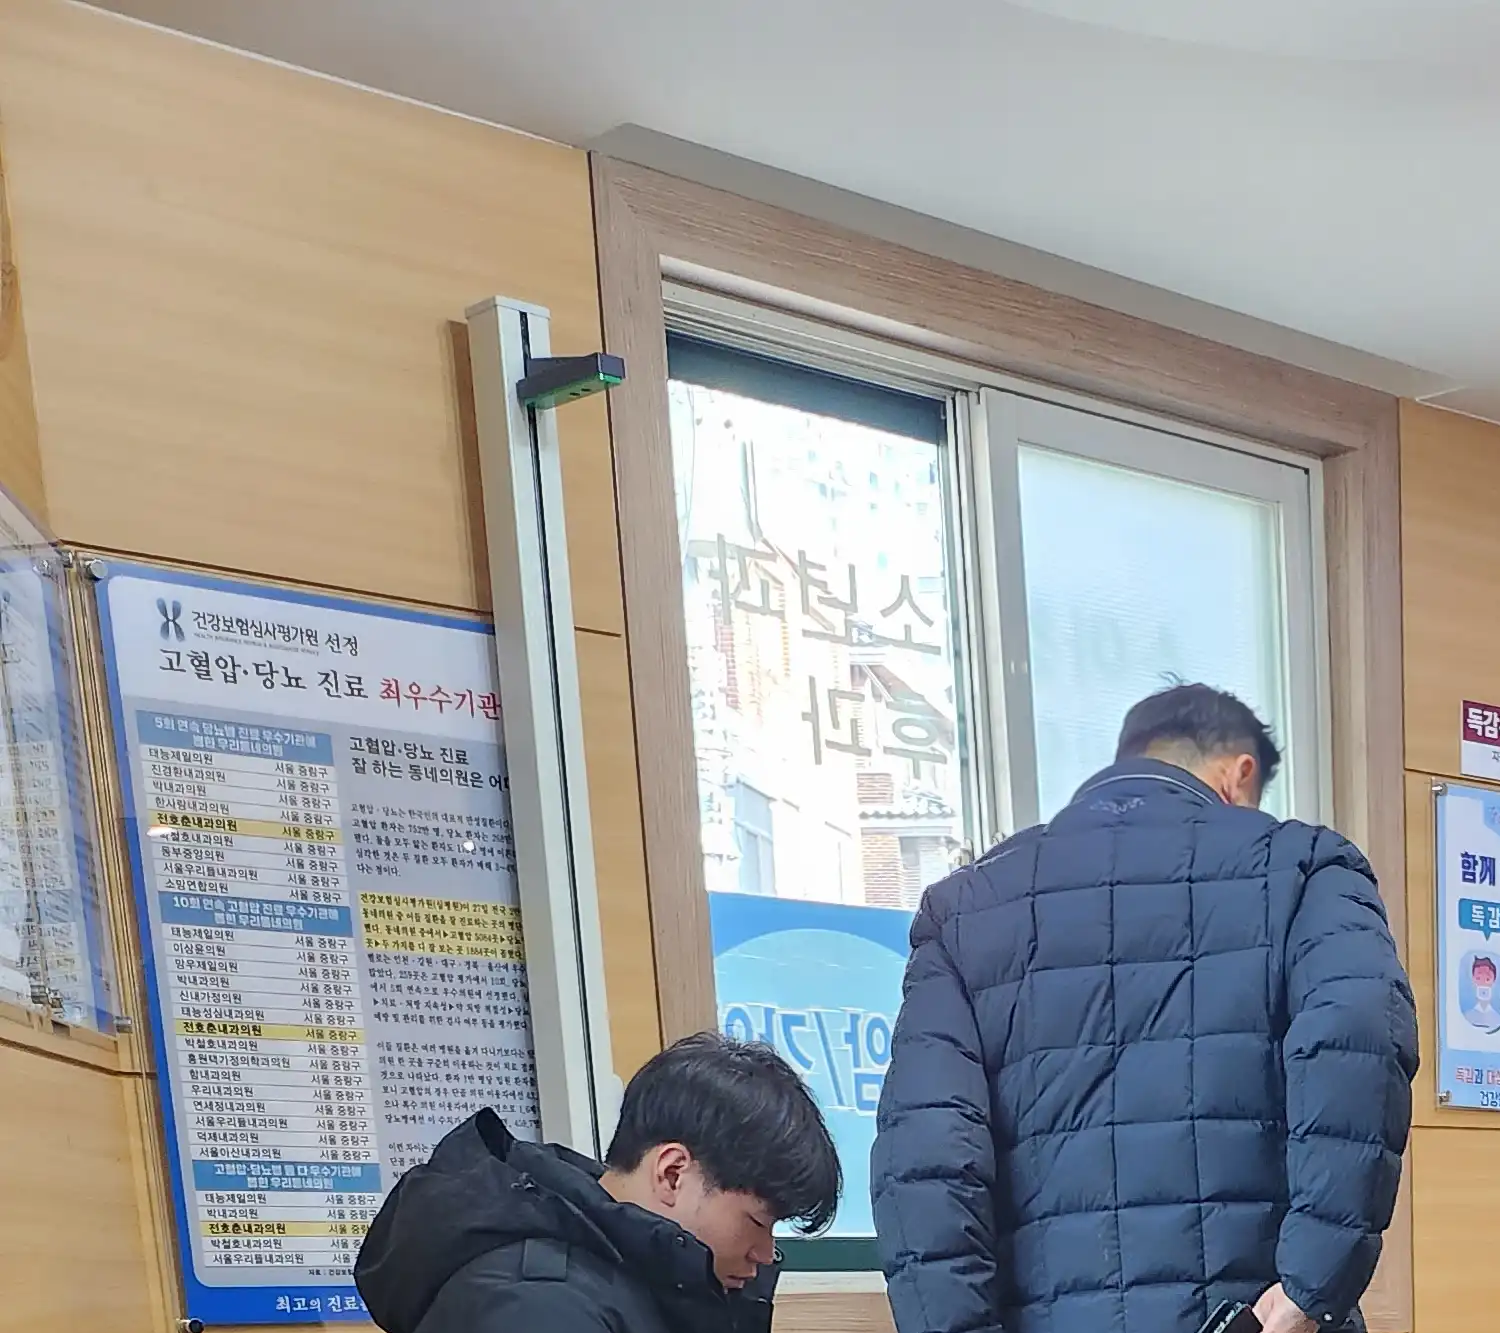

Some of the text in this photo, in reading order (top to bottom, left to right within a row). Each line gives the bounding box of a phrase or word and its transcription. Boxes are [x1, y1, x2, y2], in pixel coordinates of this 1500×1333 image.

[191, 610, 319, 646] 건강보험심사평가원
[324, 632, 359, 657] 선정
[159, 648, 501, 721] 고혈압·당뇨 진료 최우수기관
[349, 736, 469, 766] 고혈압·당뇨 진료
[274, 762, 294, 775] 서울
[351, 757, 367, 775] 잘
[372, 760, 403, 779] 하는
[408, 764, 484, 789] 동네의원은
[276, 778, 296, 791] 서울
[152, 780, 207, 797] 박내과의원
[278, 794, 298, 807] 서울
[280, 810, 300, 823] 서울
[282, 825, 302, 839] 서울
[284, 842, 303, 855] 서울
[286, 857, 305, 870] 서울
[1460, 851, 1496, 887] 함께
[287, 873, 307, 886] 서울
[289, 889, 309, 901] 서울
[295, 936, 314, 949] 서울
[296, 951, 316, 963] 서울
[299, 967, 318, 979] 서울
[177, 974, 230, 988] 박내과의원
[300, 982, 320, 994] 서울
[302, 997, 322, 1010] 서울
[304, 1013, 323, 1025] 서울
[305, 1028, 325, 1040] 서울
[307, 1043, 327, 1055] 서울
[309, 1058, 329, 1071] 서울
[310, 1074, 330, 1086] 서울
[313, 1089, 332, 1101] 서울
[315, 1104, 334, 1116] 서울
[316, 1119, 336, 1131] 서울
[318, 1134, 338, 1146] 서울
[320, 1149, 339, 1161] 서울
[325, 1194, 344, 1205] 서울
[207, 1208, 259, 1220] 박내과의원
[327, 1208, 346, 1220] 서울
[329, 1223, 347, 1235] 서울
[330, 1239, 349, 1250] 서울
[332, 1253, 351, 1264] 서울
[275, 1295, 322, 1313] 최고의
